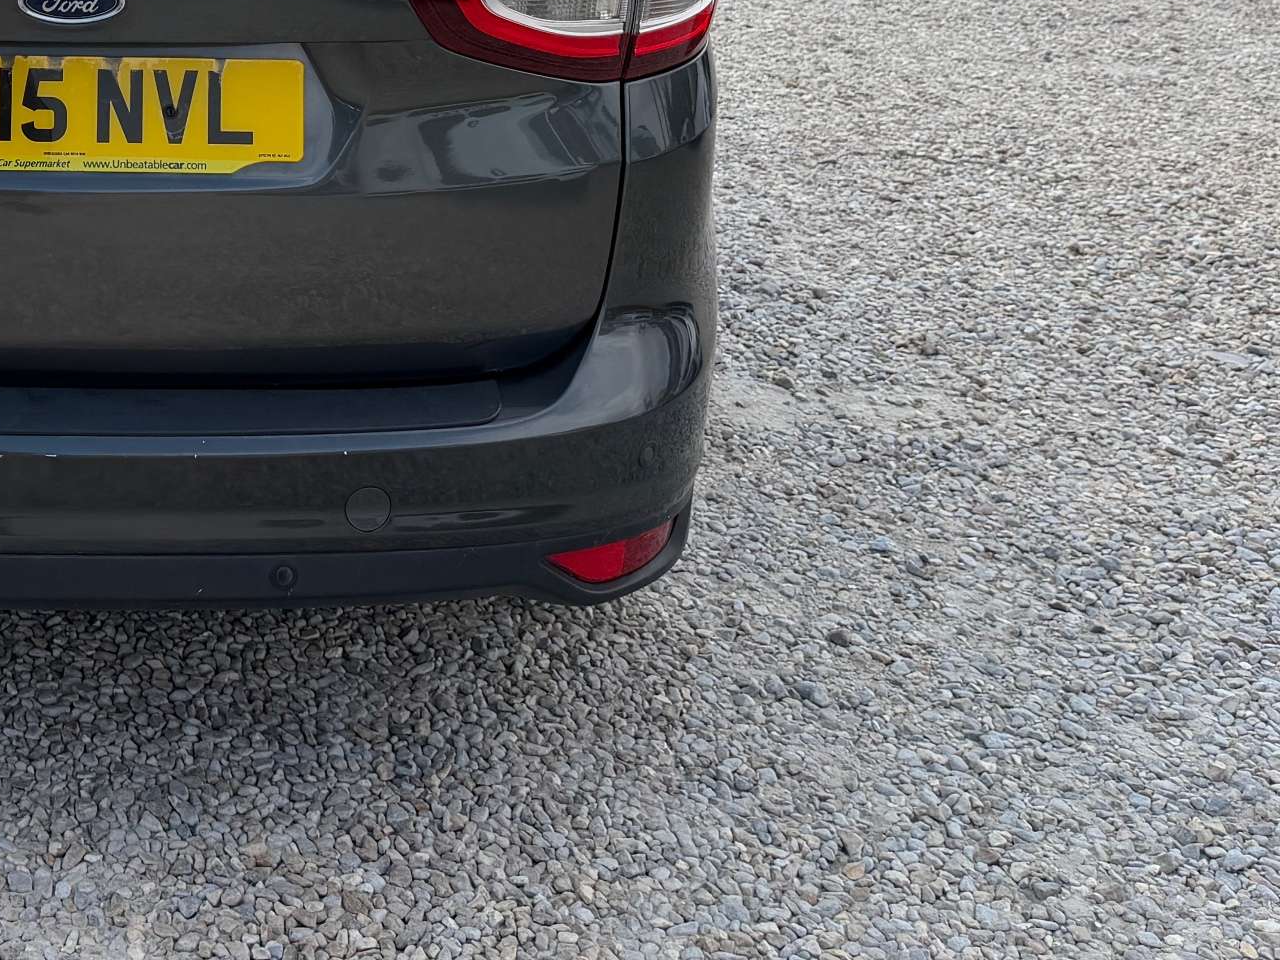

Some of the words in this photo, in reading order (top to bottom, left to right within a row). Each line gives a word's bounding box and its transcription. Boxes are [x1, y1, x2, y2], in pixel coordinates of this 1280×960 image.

[95, 68, 254, 145] NVL
[14, 158, 71, 170] Supermarket
[83, 159, 207, 172] www.Unbeatablecar.com
